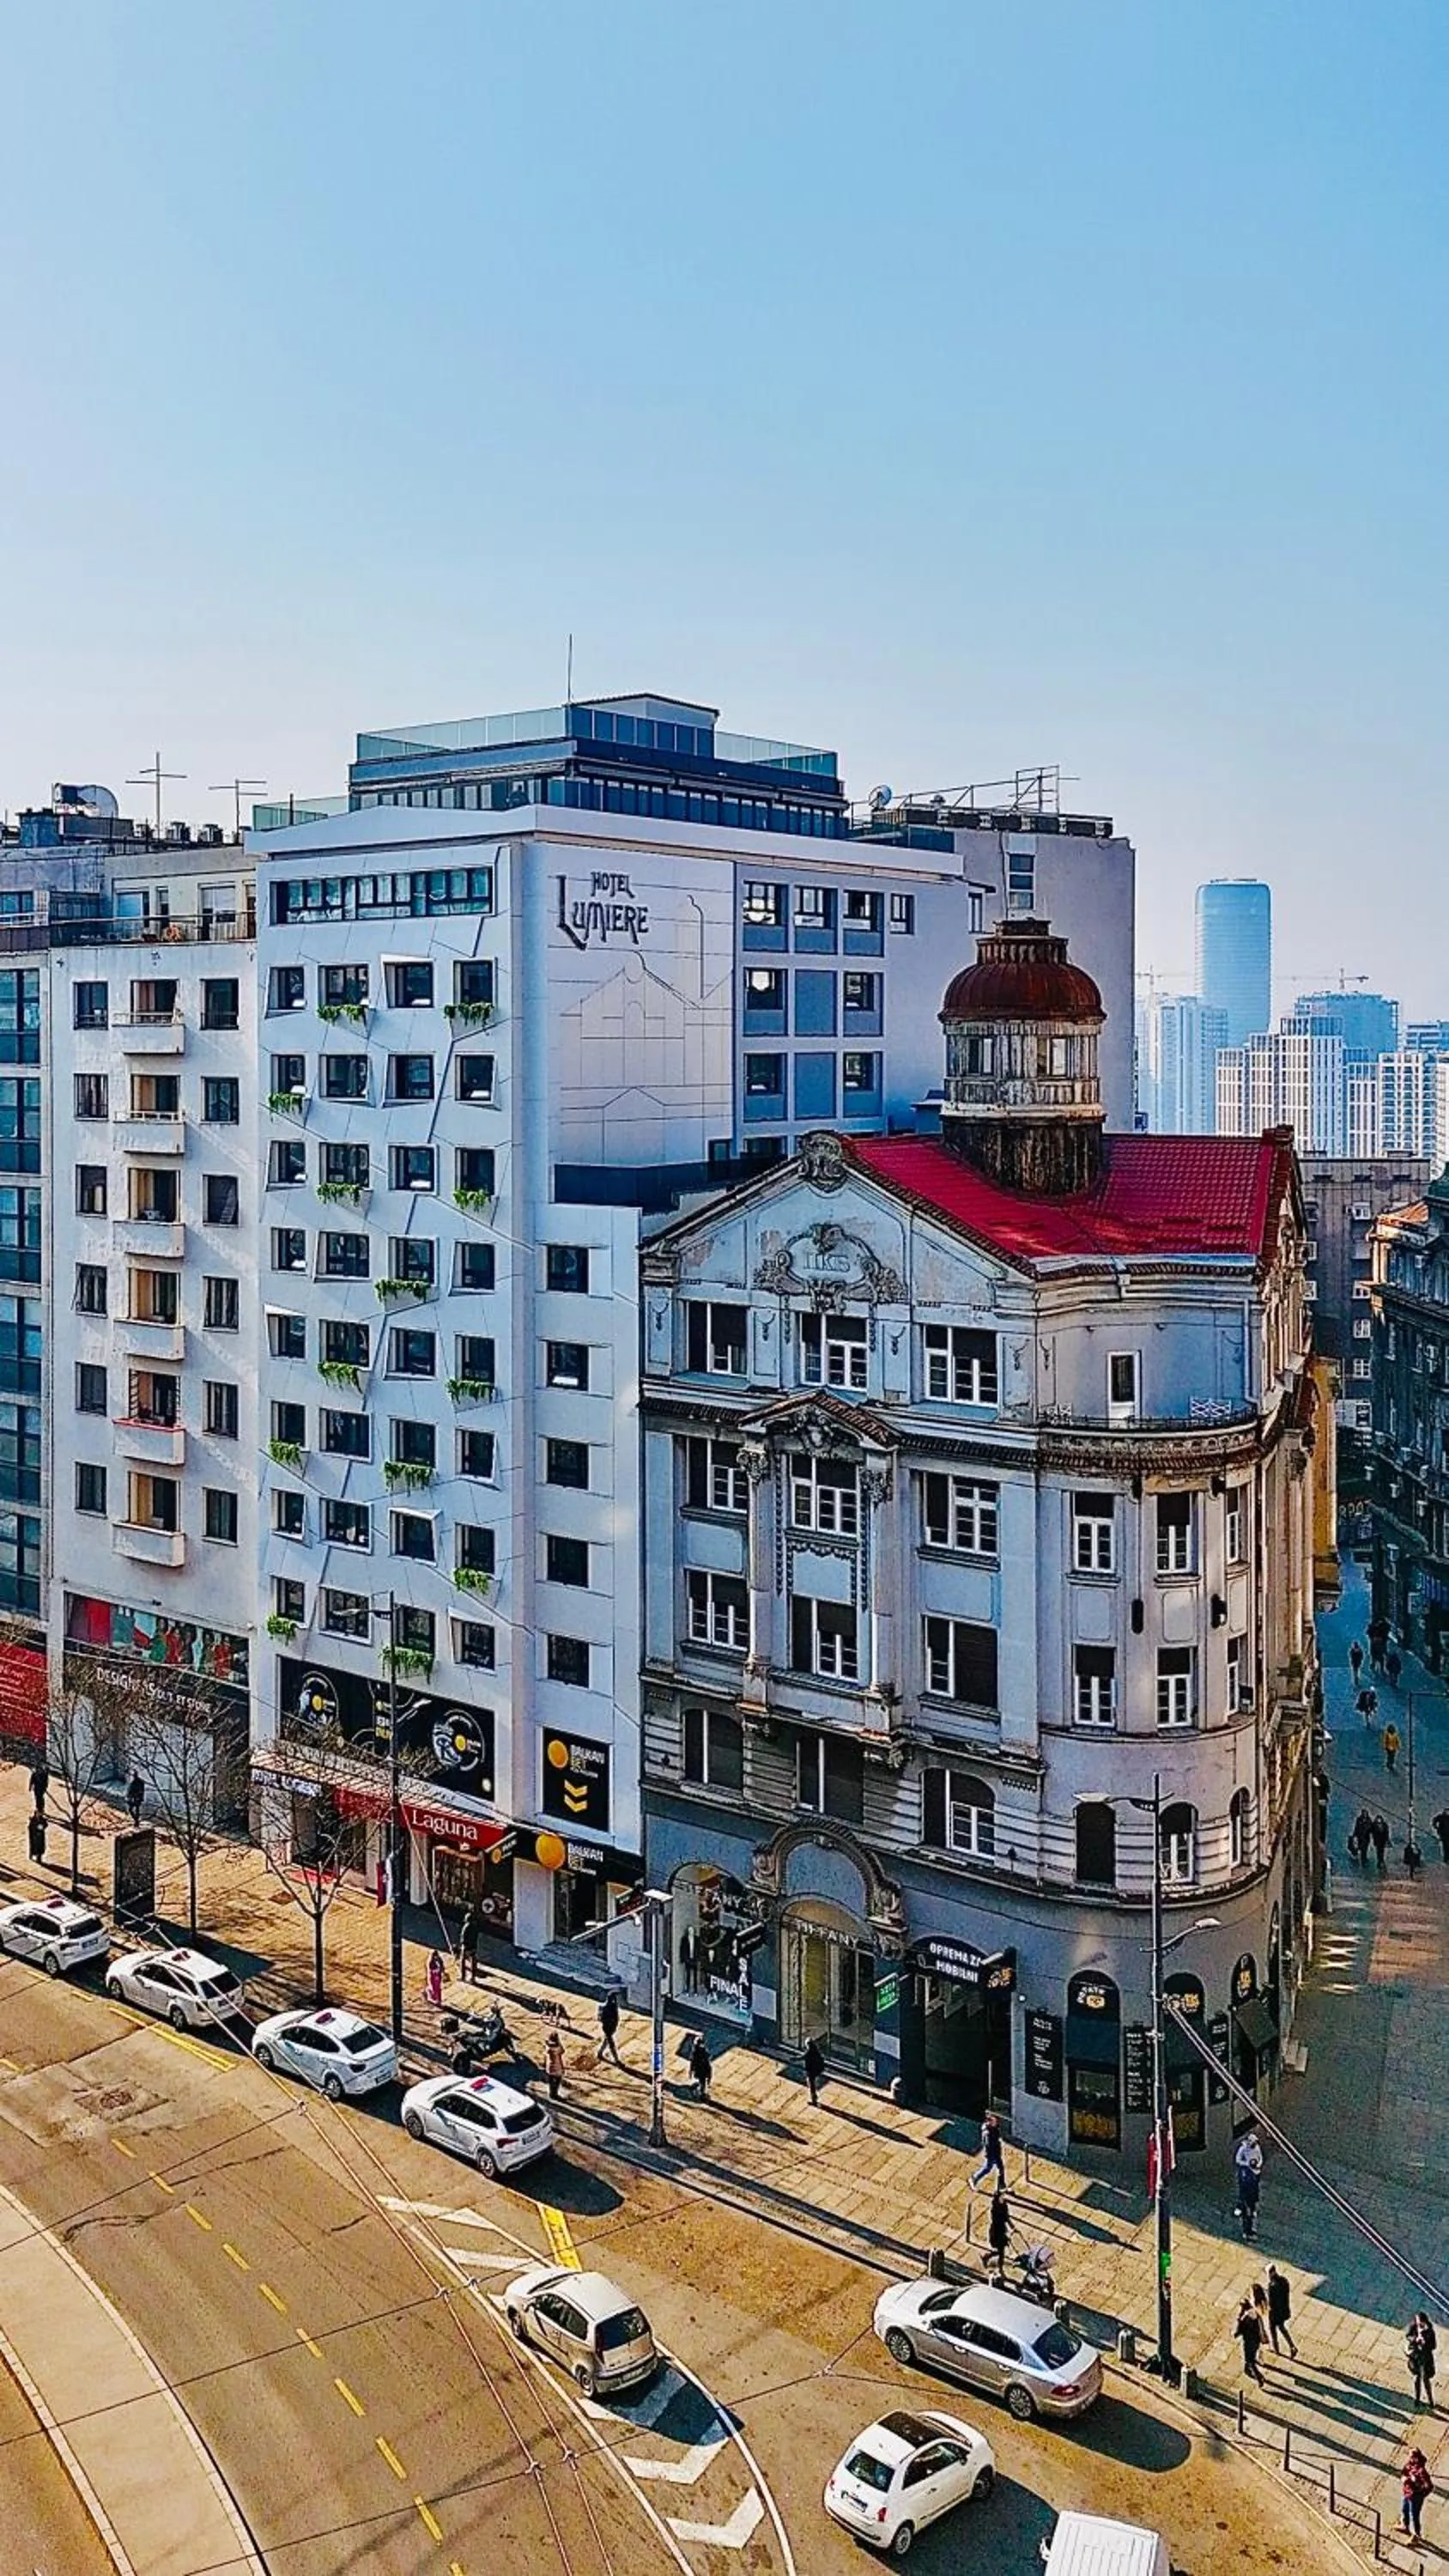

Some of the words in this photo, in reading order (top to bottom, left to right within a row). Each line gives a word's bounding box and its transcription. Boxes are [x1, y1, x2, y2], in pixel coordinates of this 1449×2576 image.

[591, 871, 635, 898] HOTEL
[556, 874, 650, 951] LUMIERE
[411, 1809, 478, 1841] Laguna
[797, 1919, 858, 1947] TIFFANY
[930, 1941, 968, 1965] OPREMA
[738, 1957, 749, 2012] SALE
[935, 1959, 979, 1983] MOBILNI
[709, 1974, 739, 1997] FINAL
